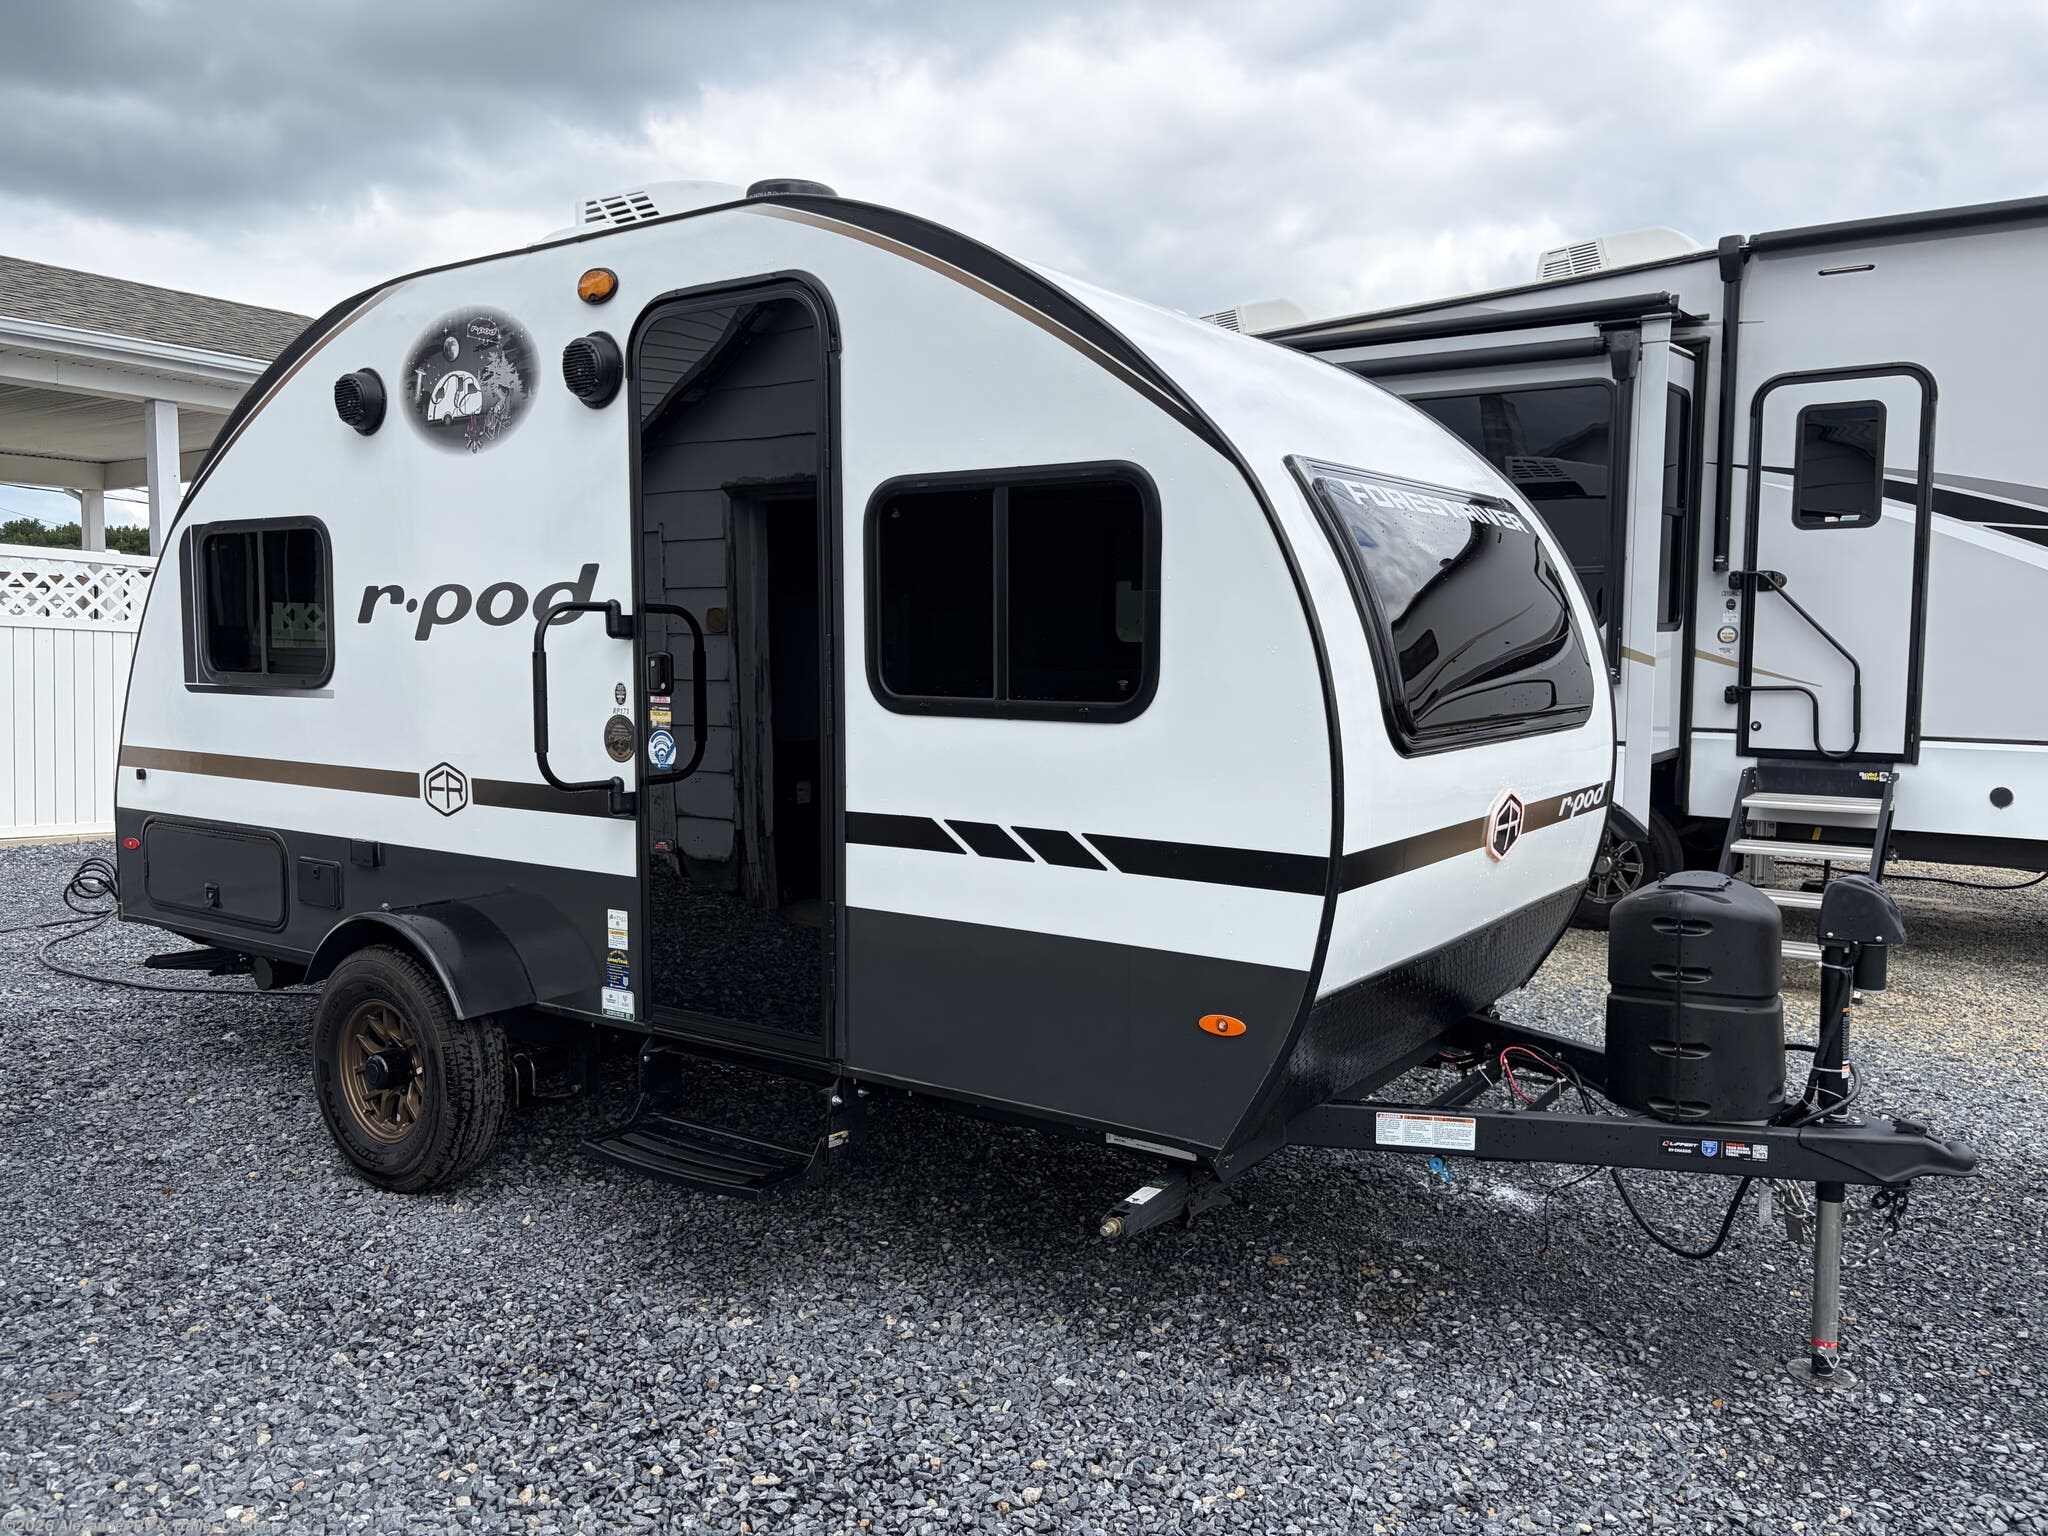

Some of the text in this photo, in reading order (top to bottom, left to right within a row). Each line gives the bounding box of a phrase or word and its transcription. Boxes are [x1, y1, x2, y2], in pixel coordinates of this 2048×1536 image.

[1349, 481, 1530, 535] FOREST RIVER
[612, 707, 630, 715] RP171
